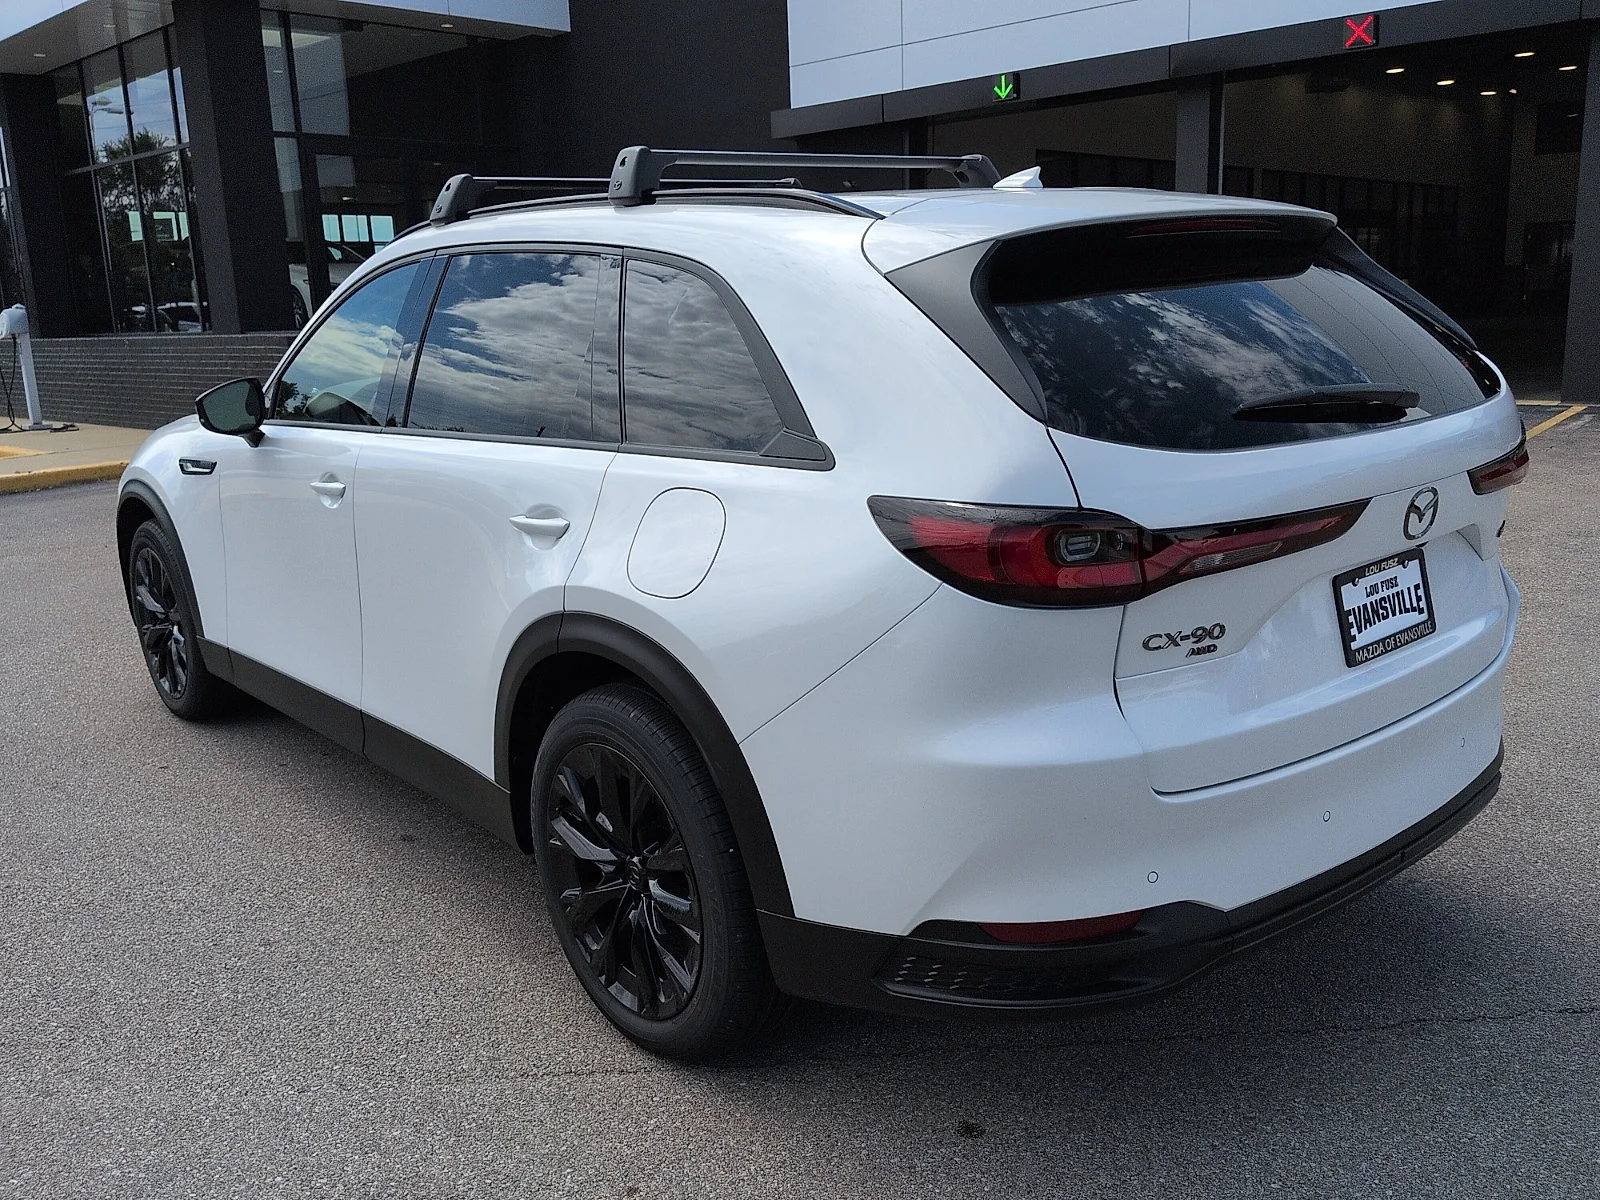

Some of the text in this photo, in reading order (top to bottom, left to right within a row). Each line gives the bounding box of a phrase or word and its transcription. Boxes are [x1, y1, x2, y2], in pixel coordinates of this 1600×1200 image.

[1365, 558, 1399, 576] LOU FUSZ
[1365, 576, 1399, 598] LOU FUSZ
[1345, 583, 1425, 641] EVANSVILLE
[1142, 622, 1226, 651] CX-90
[1355, 621, 1433, 663] MAZDA OF EVANSVILLE
[1185, 643, 1218, 658] AWD
